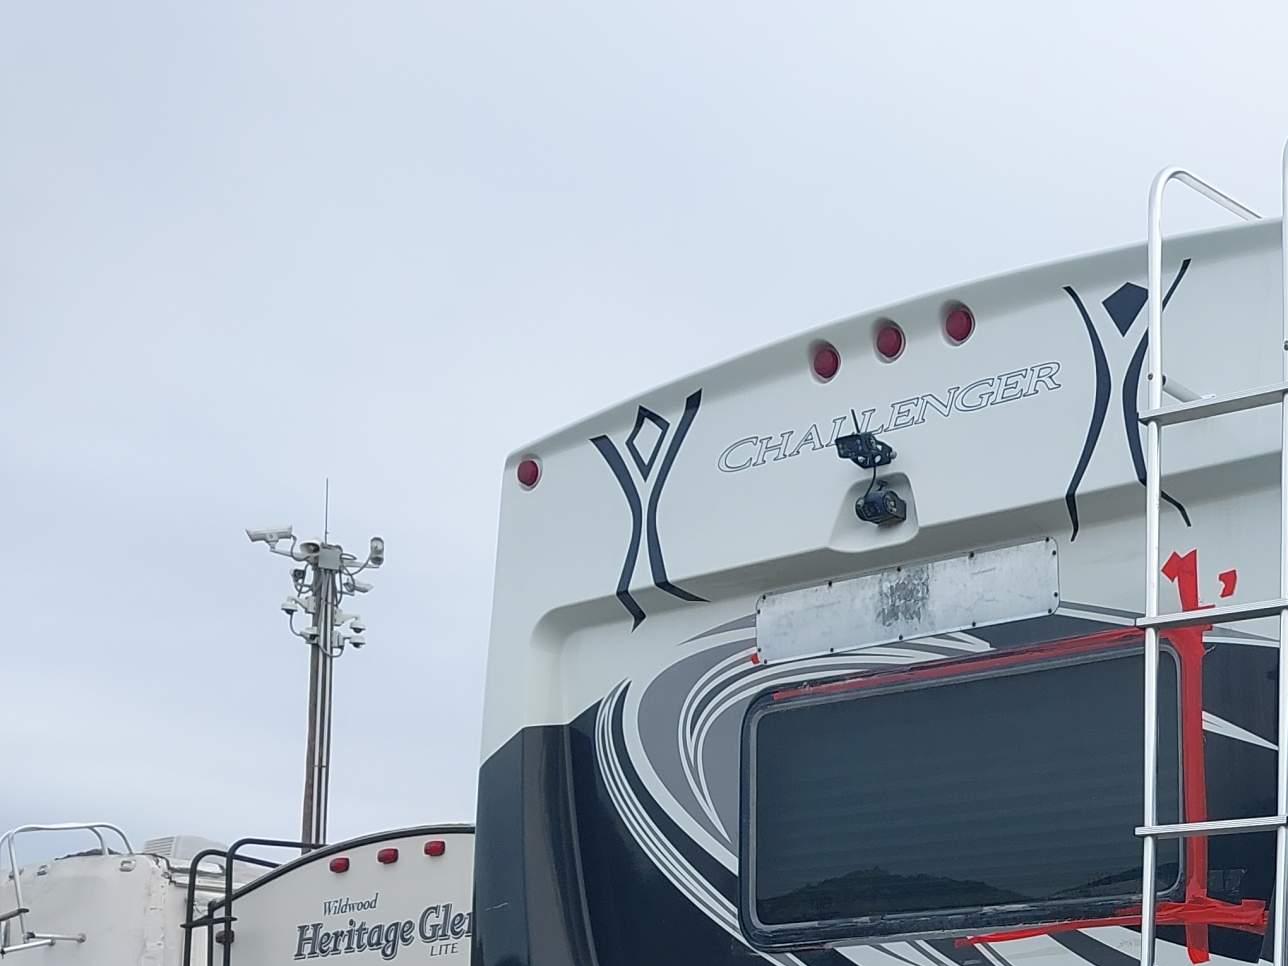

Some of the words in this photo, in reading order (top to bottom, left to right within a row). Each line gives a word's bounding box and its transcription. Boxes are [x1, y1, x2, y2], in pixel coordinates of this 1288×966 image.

[323, 893, 379, 916] Wildwood
[294, 919, 415, 960] Heritage
[430, 943, 459, 957] LITE
